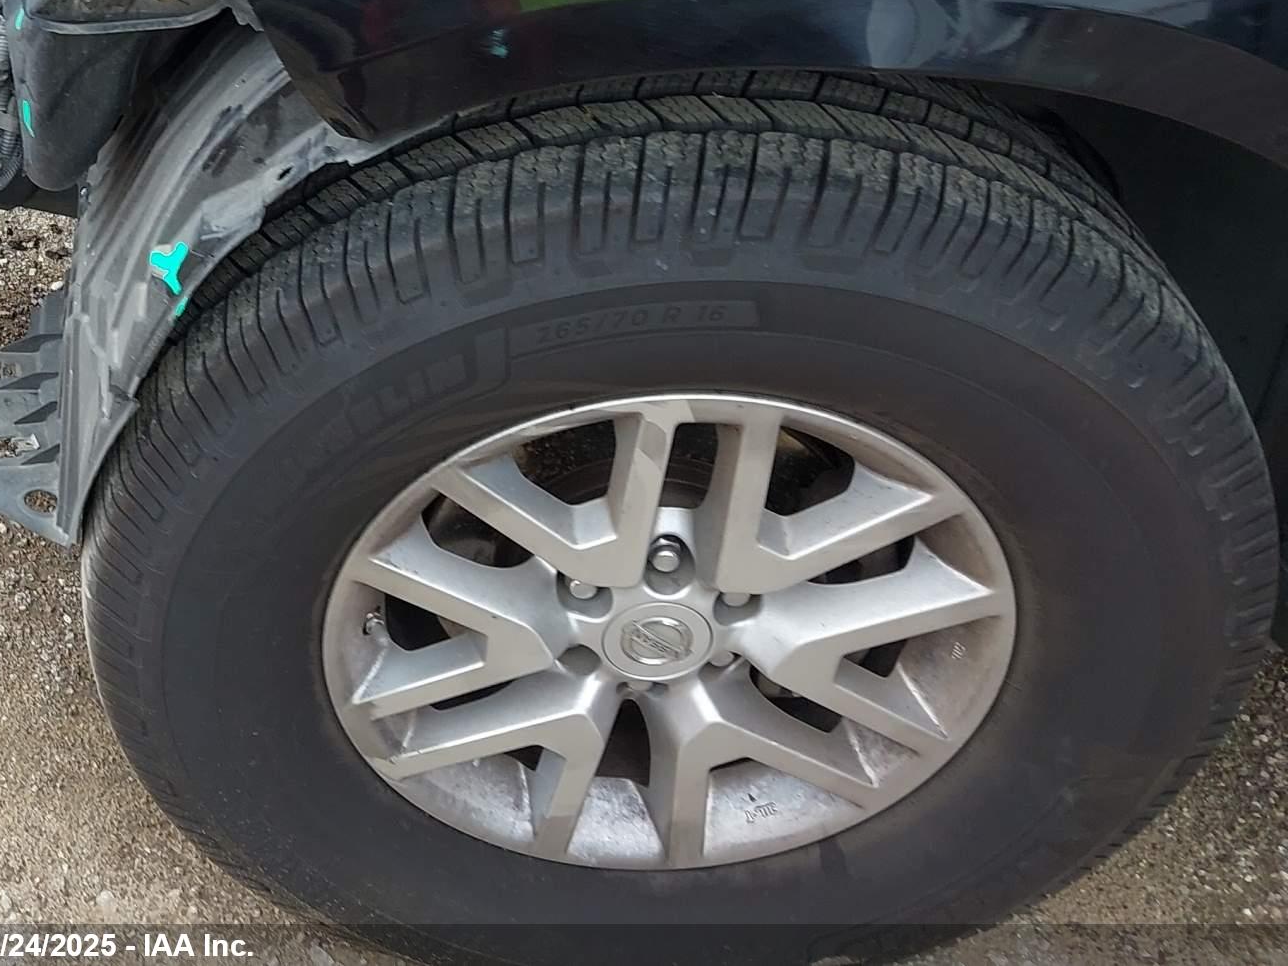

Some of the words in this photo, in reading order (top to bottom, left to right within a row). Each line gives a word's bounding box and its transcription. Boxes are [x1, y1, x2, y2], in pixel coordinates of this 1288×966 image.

[536, 309, 649, 345] 265/70
[663, 306, 682, 324] R
[697, 305, 727, 322] 16
